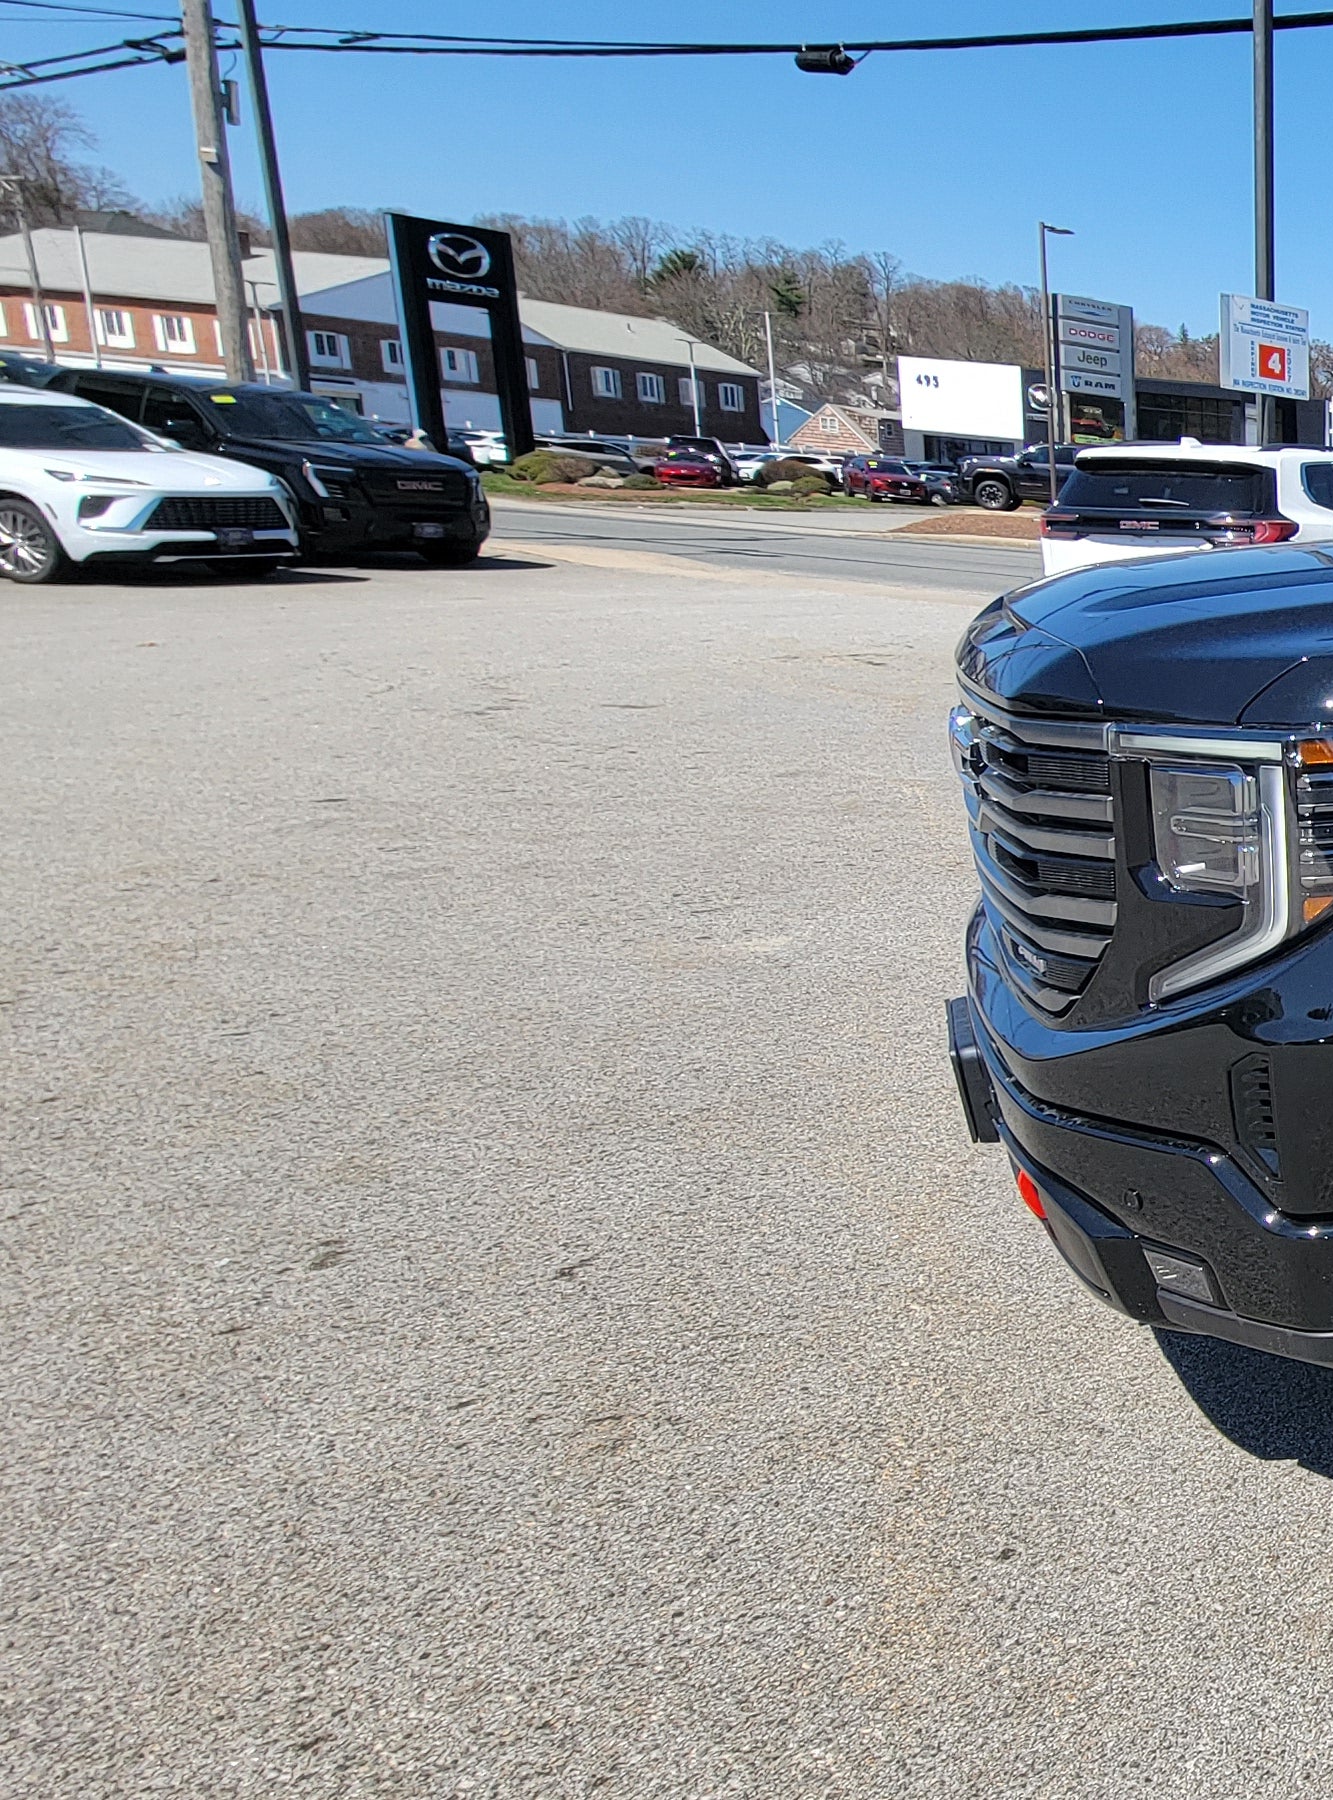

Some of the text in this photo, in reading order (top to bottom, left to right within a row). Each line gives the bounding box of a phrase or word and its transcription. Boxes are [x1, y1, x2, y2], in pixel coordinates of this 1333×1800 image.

[425, 277, 500, 298] mazda
[1250, 303, 1299, 319] MASSACHUSETTS
[1068, 327, 1116, 342] DODGE
[1077, 350, 1108, 368] Jeep
[1268, 352, 1282, 374] 4
[1084, 380, 1116, 390] RAM
[396, 480, 445, 491] GMC
[1119, 520, 1160, 530] GMC
